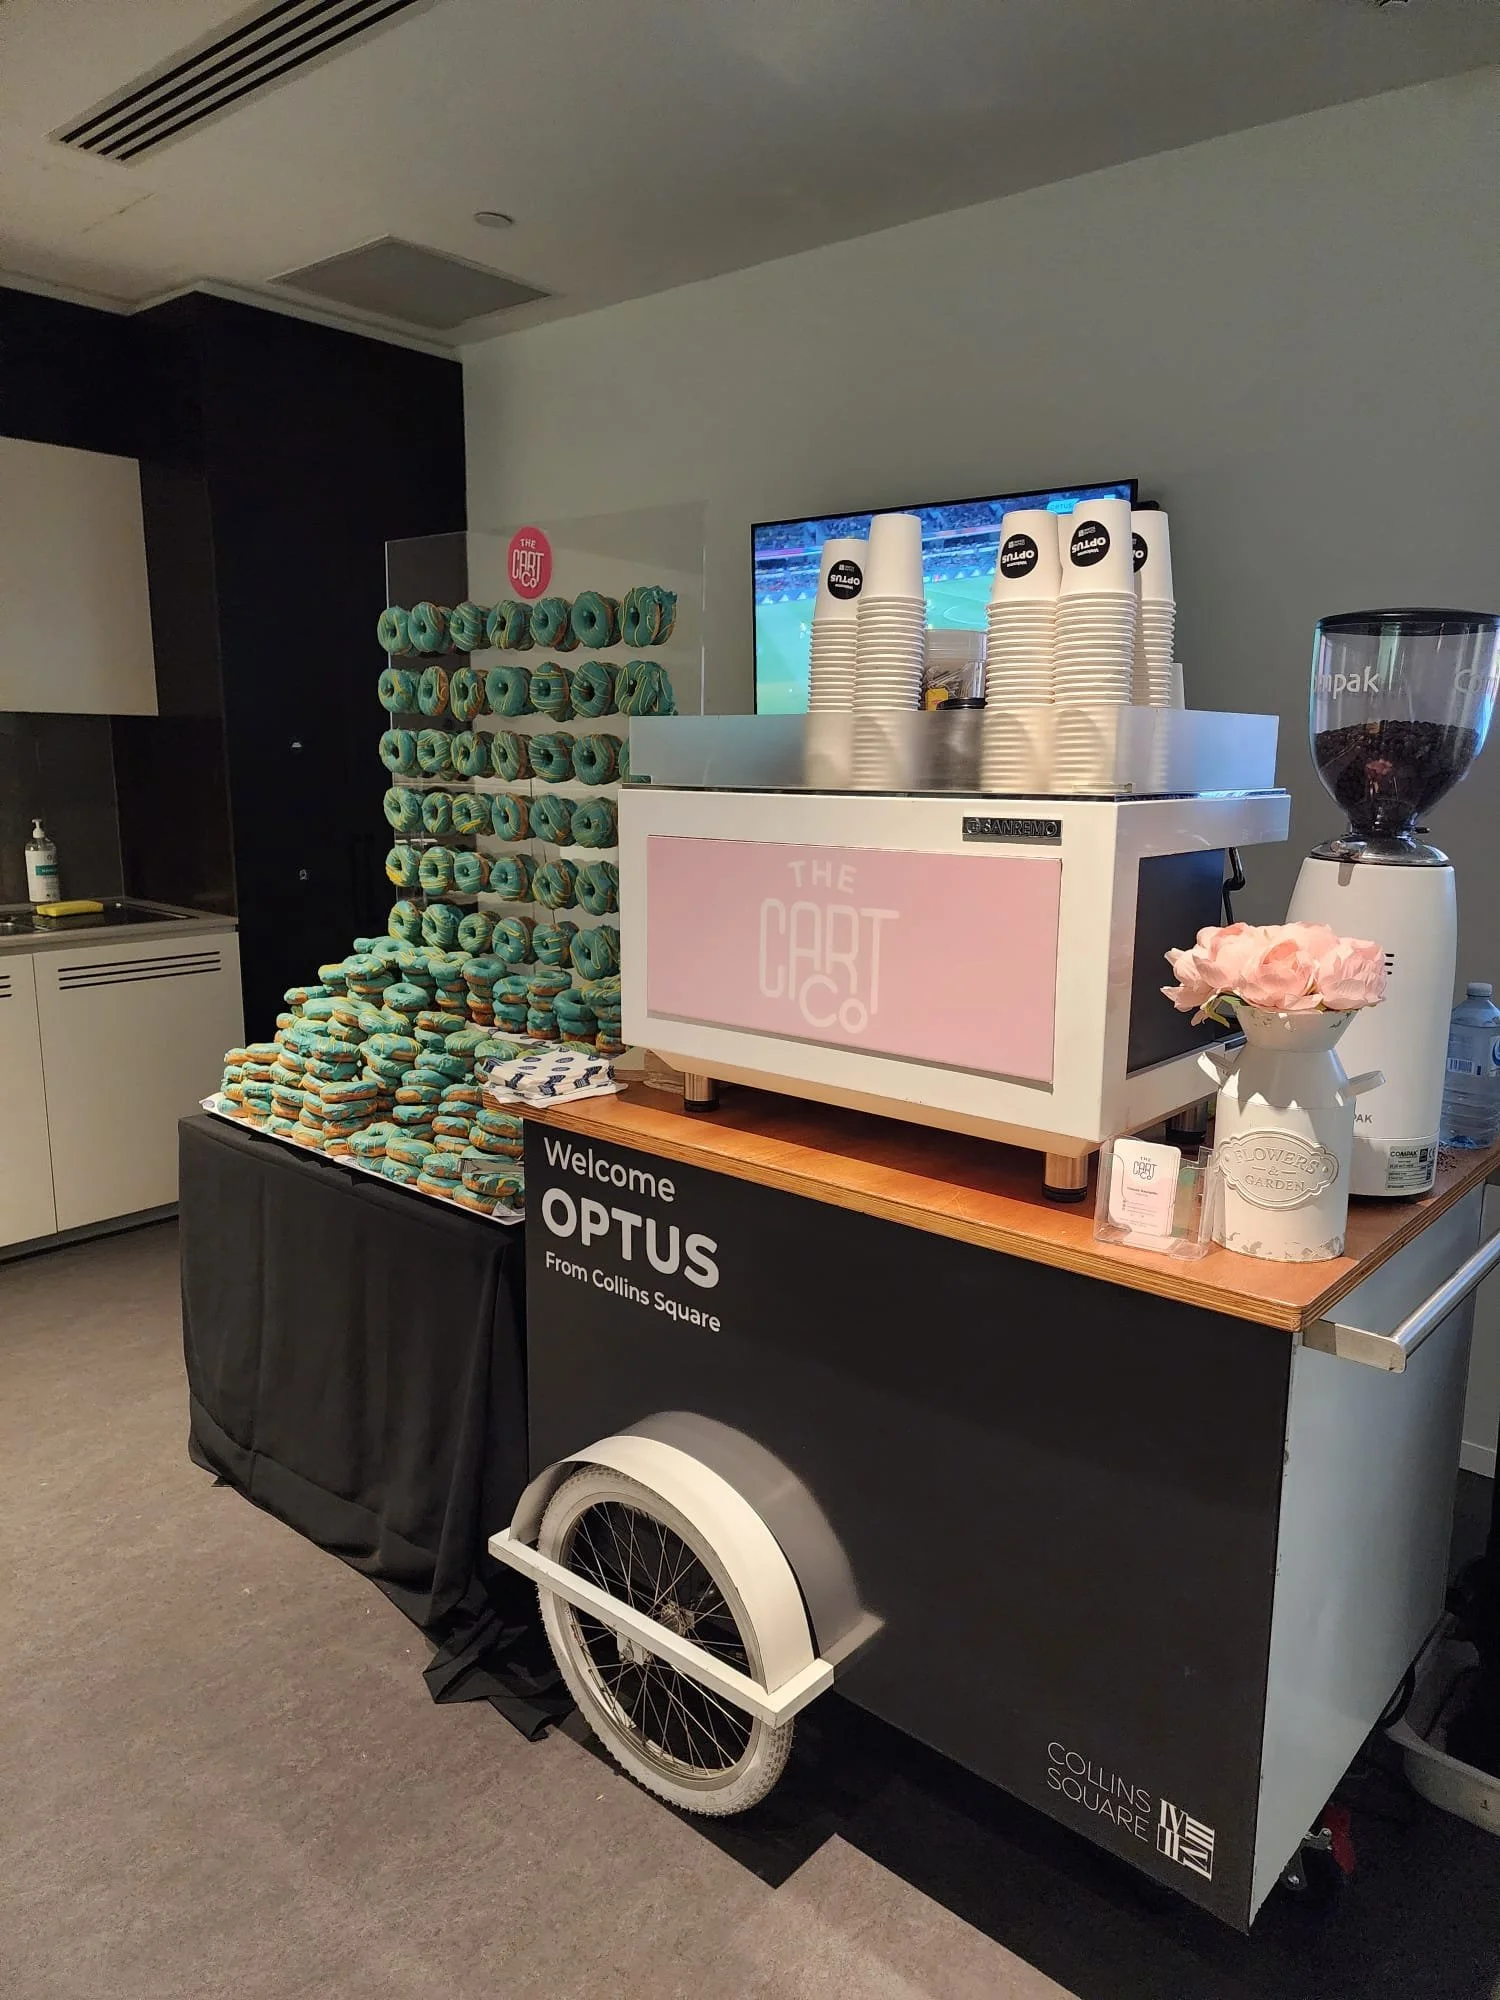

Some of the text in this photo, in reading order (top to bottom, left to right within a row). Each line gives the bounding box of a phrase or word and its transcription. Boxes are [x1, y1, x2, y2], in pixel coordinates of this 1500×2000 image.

[520, 538, 536, 549] THE
[1002, 550, 1035, 564] OPTUS
[1072, 537, 1106, 554] OPTUS
[512, 549, 544, 582] CART
[830, 574, 860, 585] OPTUS
[983, 819, 1058, 836] SANREMO
[787, 859, 857, 894] THE
[758, 898, 900, 1015] CART
[799, 974, 868, 1034] Co
[543, 1136, 676, 1202] Welcome
[1234, 1147, 1320, 1176] FLOWERS
[1244, 1174, 1305, 1192] GARDEN
[541, 1187, 720, 1289] OPTUS
[544, 1250, 721, 1332] From Collins Square
[1047, 1742, 1151, 1813] COLLINS
[1047, 1767, 1149, 1842] SQUARE
